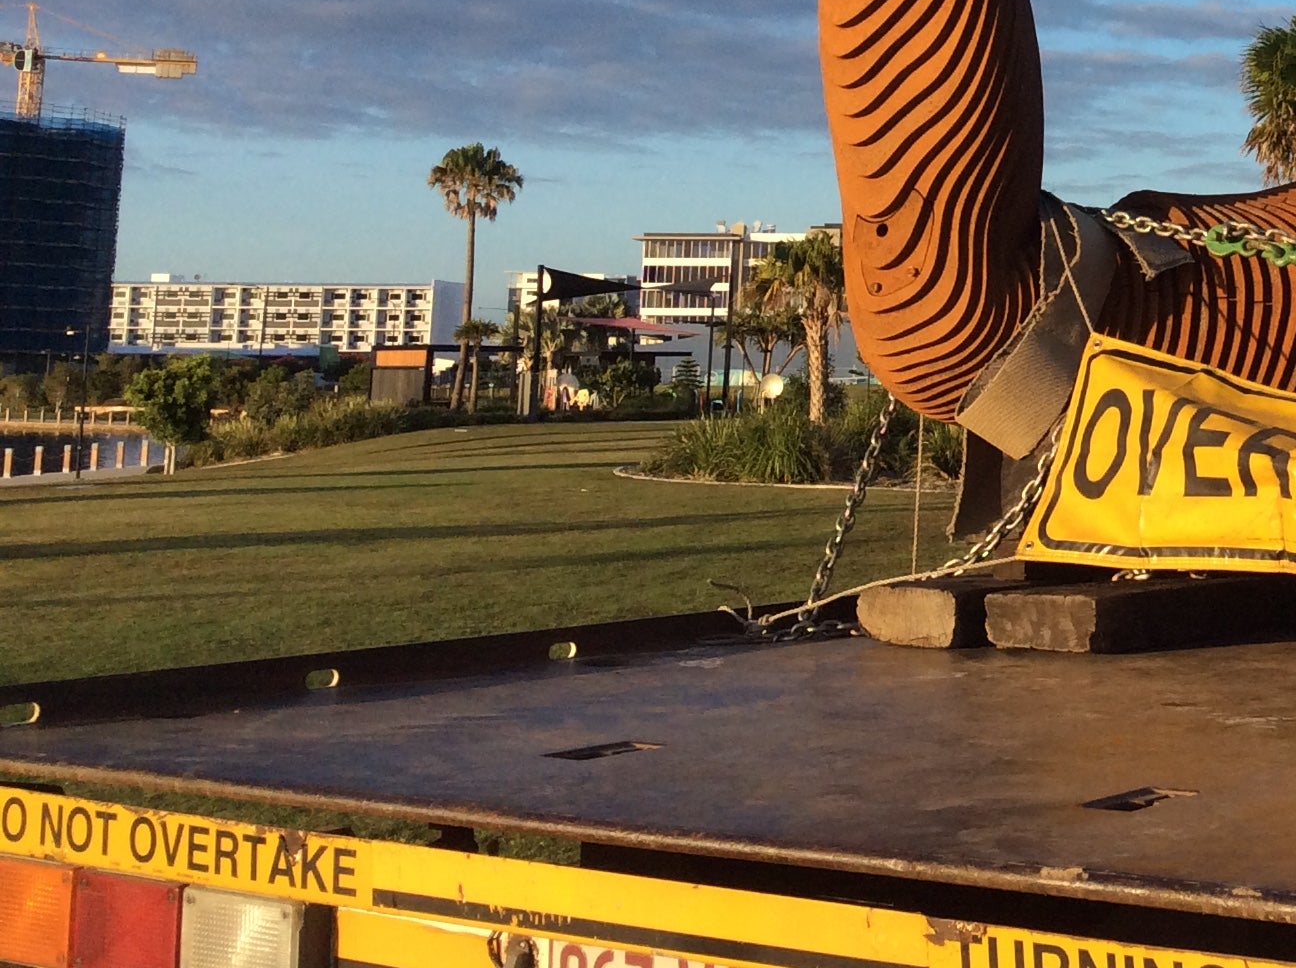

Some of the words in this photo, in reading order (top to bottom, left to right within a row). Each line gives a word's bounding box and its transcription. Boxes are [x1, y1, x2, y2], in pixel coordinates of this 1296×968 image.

[1, 796, 27, 843] O
[40, 802, 118, 856] NOT
[129, 816, 357, 898] OVERTAKE
